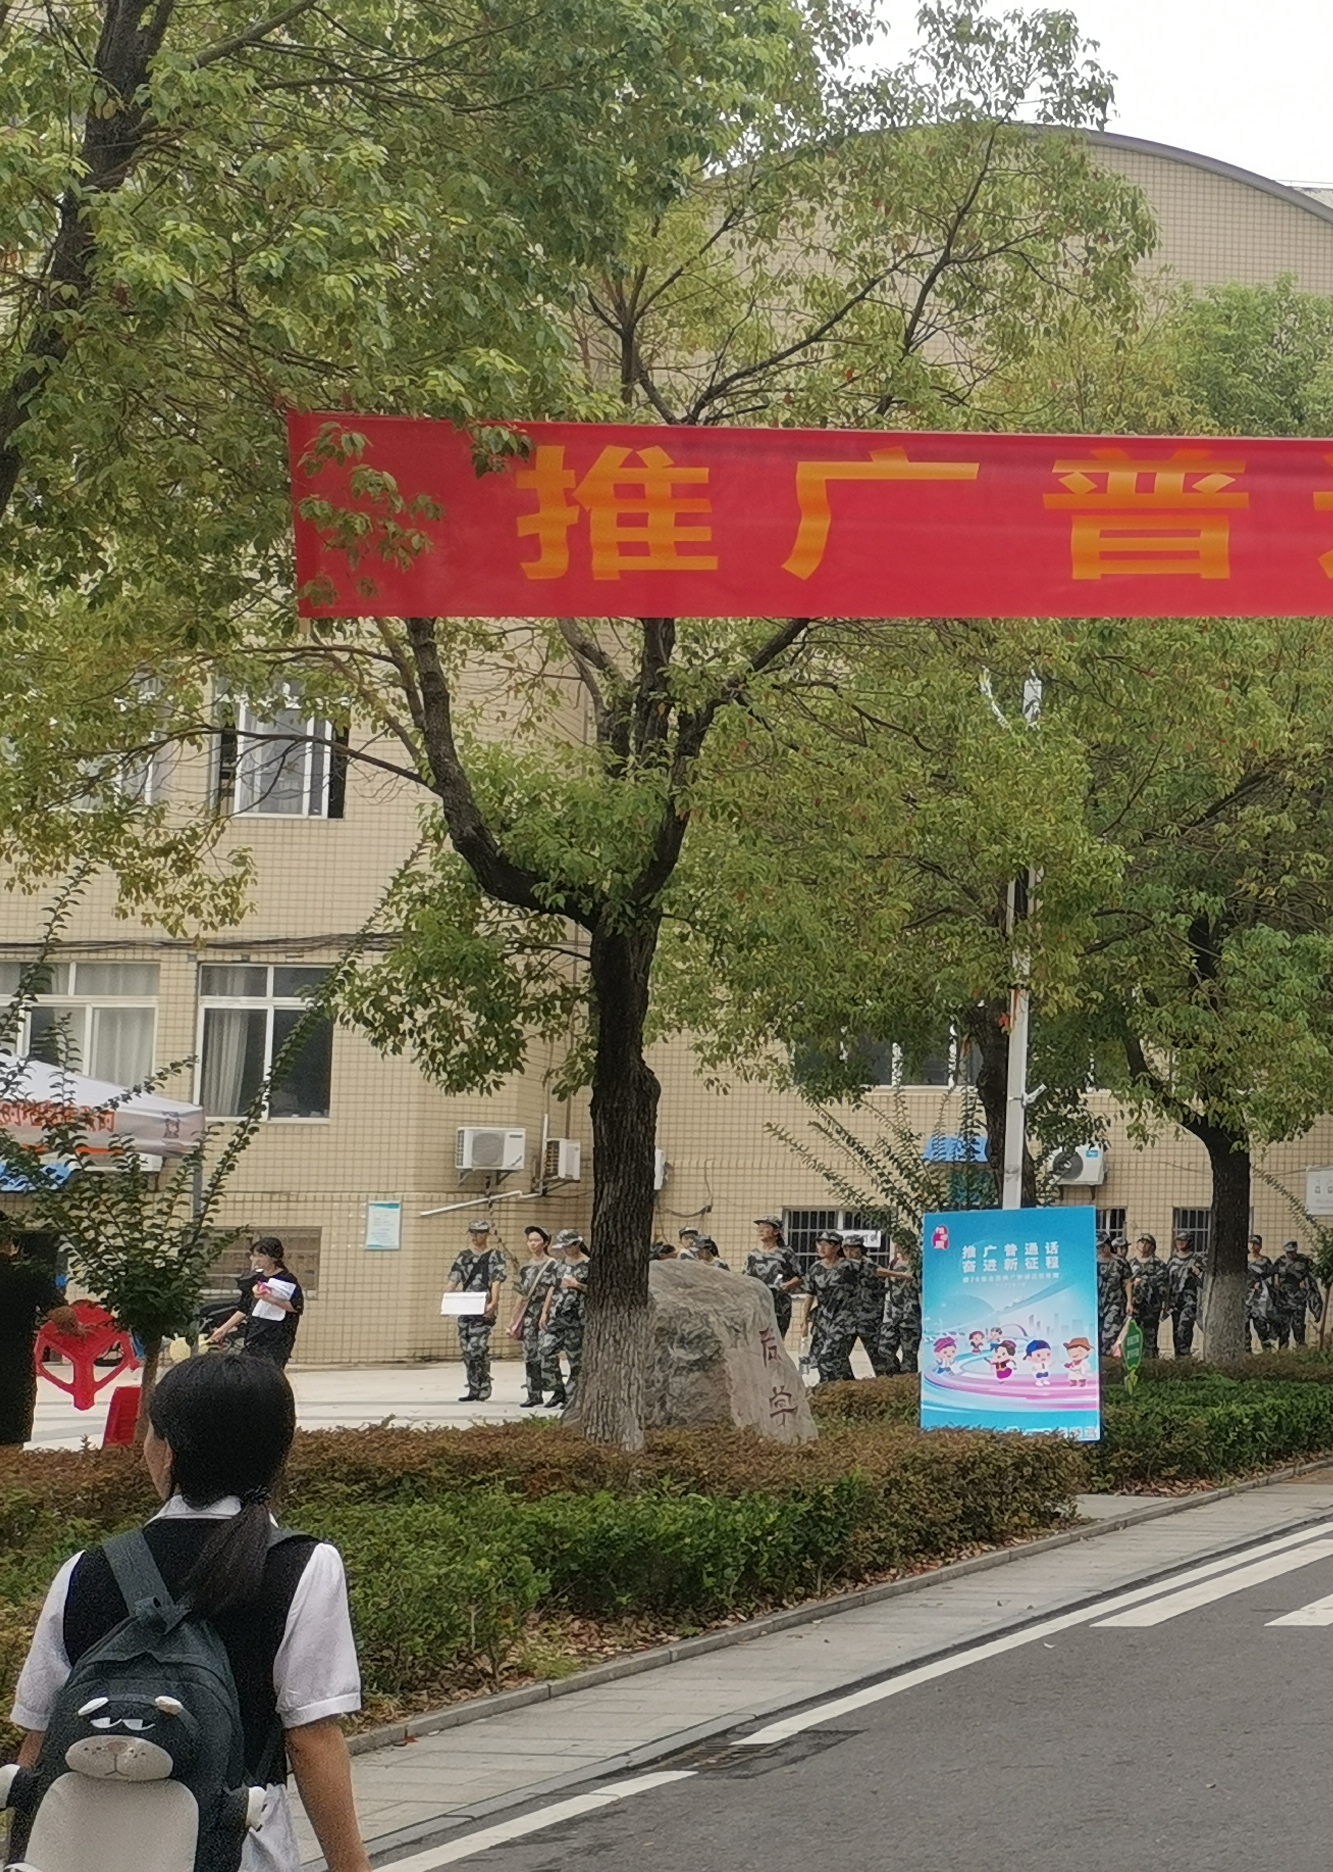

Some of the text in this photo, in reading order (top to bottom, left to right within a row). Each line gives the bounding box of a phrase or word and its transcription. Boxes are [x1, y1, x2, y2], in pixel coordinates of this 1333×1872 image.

[962, 1241, 1059, 1259] 推广普通话
[962, 1256, 1060, 1273] 奋进新征程
